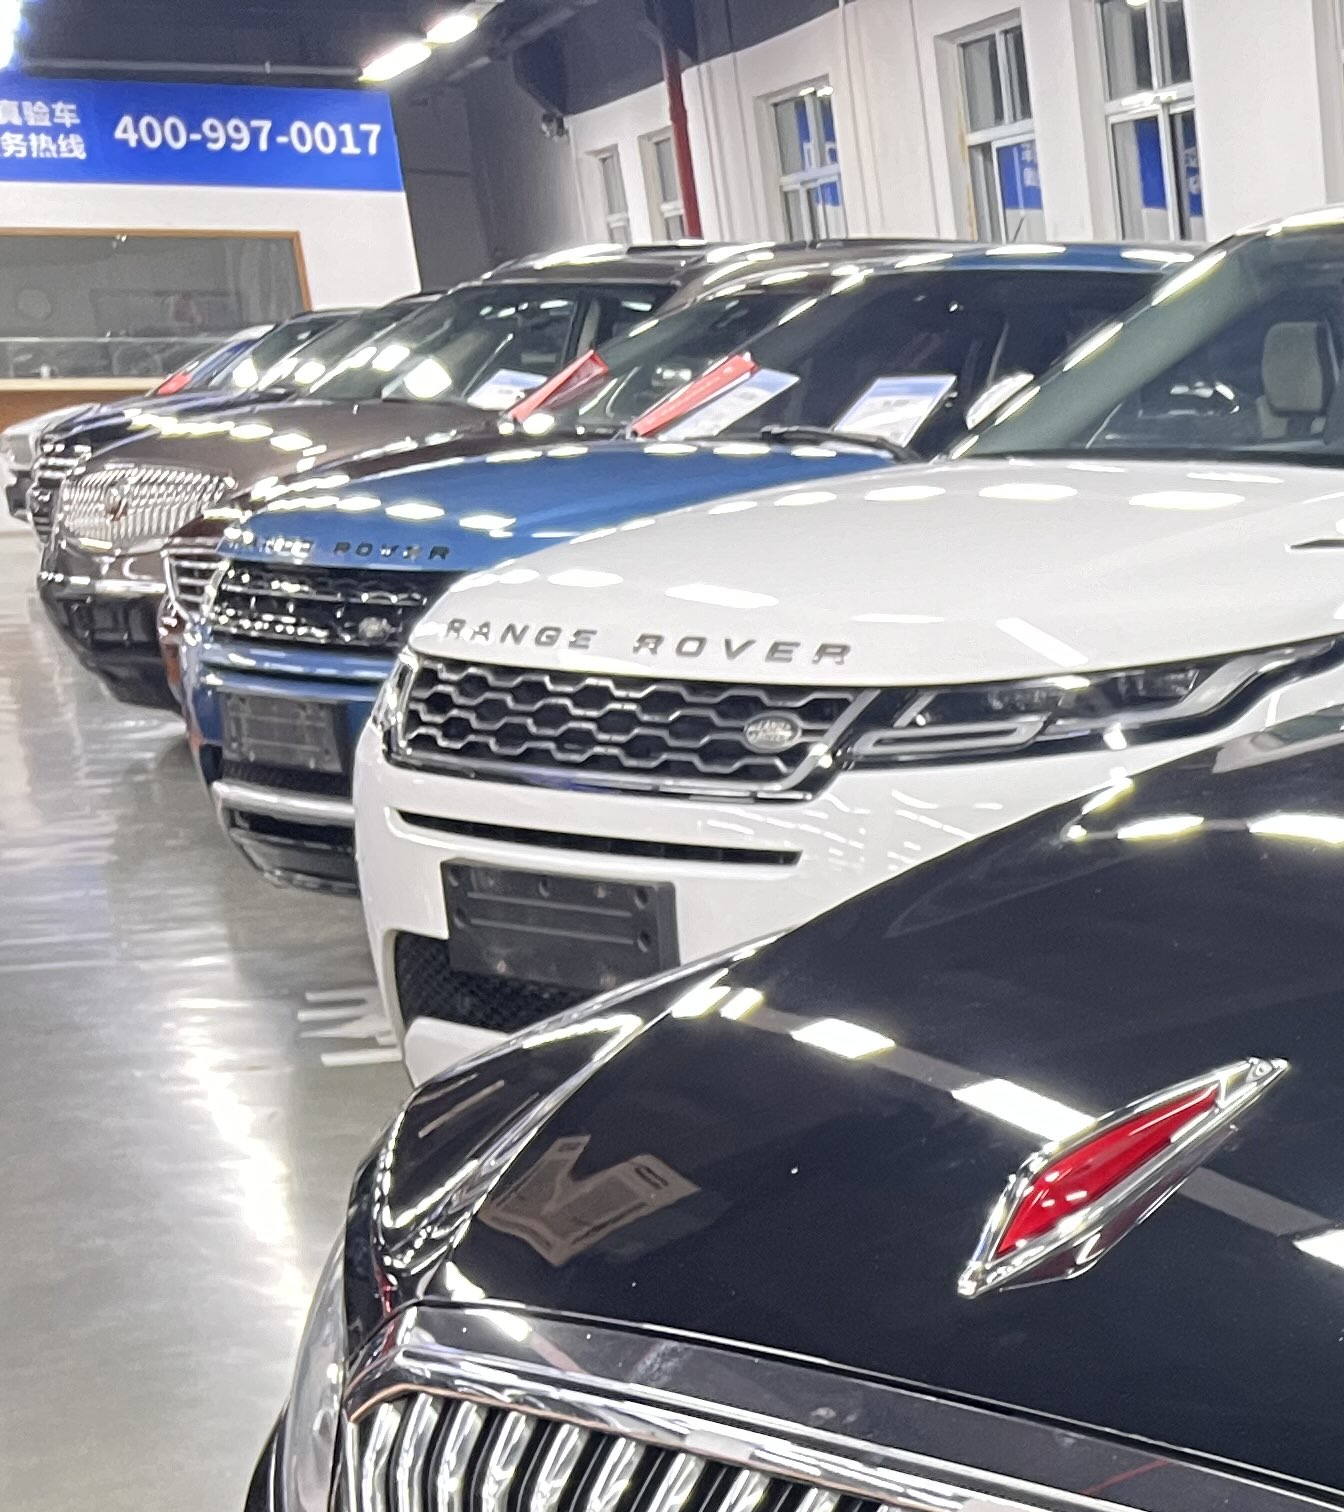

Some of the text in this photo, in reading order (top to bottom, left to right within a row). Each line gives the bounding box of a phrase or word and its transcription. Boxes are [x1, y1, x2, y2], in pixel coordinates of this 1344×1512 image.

[114, 114, 381, 156] 400-997-0017
[447, 618, 851, 666] RANGE ROVER
